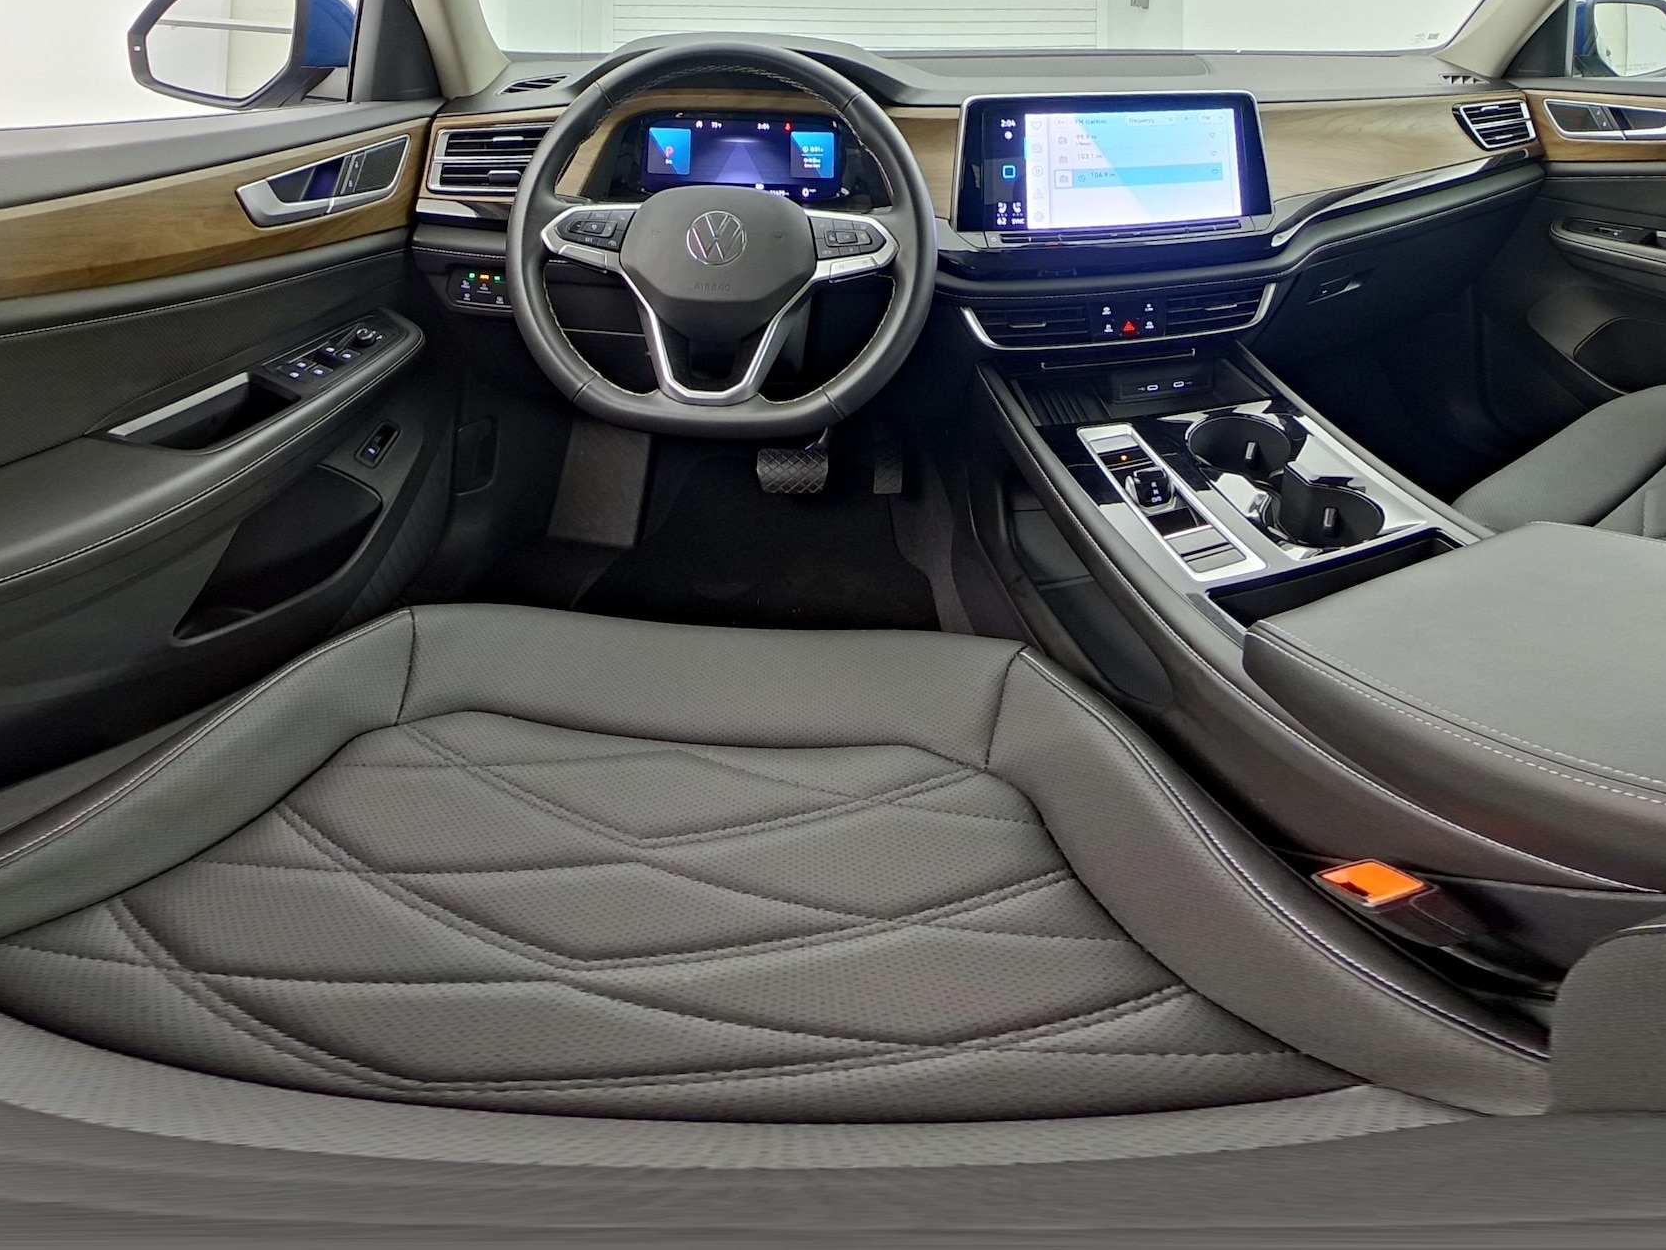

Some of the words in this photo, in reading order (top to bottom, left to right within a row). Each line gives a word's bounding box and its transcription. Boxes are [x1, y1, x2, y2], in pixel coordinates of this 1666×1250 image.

[1000, 118, 1016, 128] 2:04
[665, 145, 674, 158] P
[802, 187, 809, 197] 0
[997, 217, 1007, 225] 62
[694, 283, 731, 292] AIRBAG
